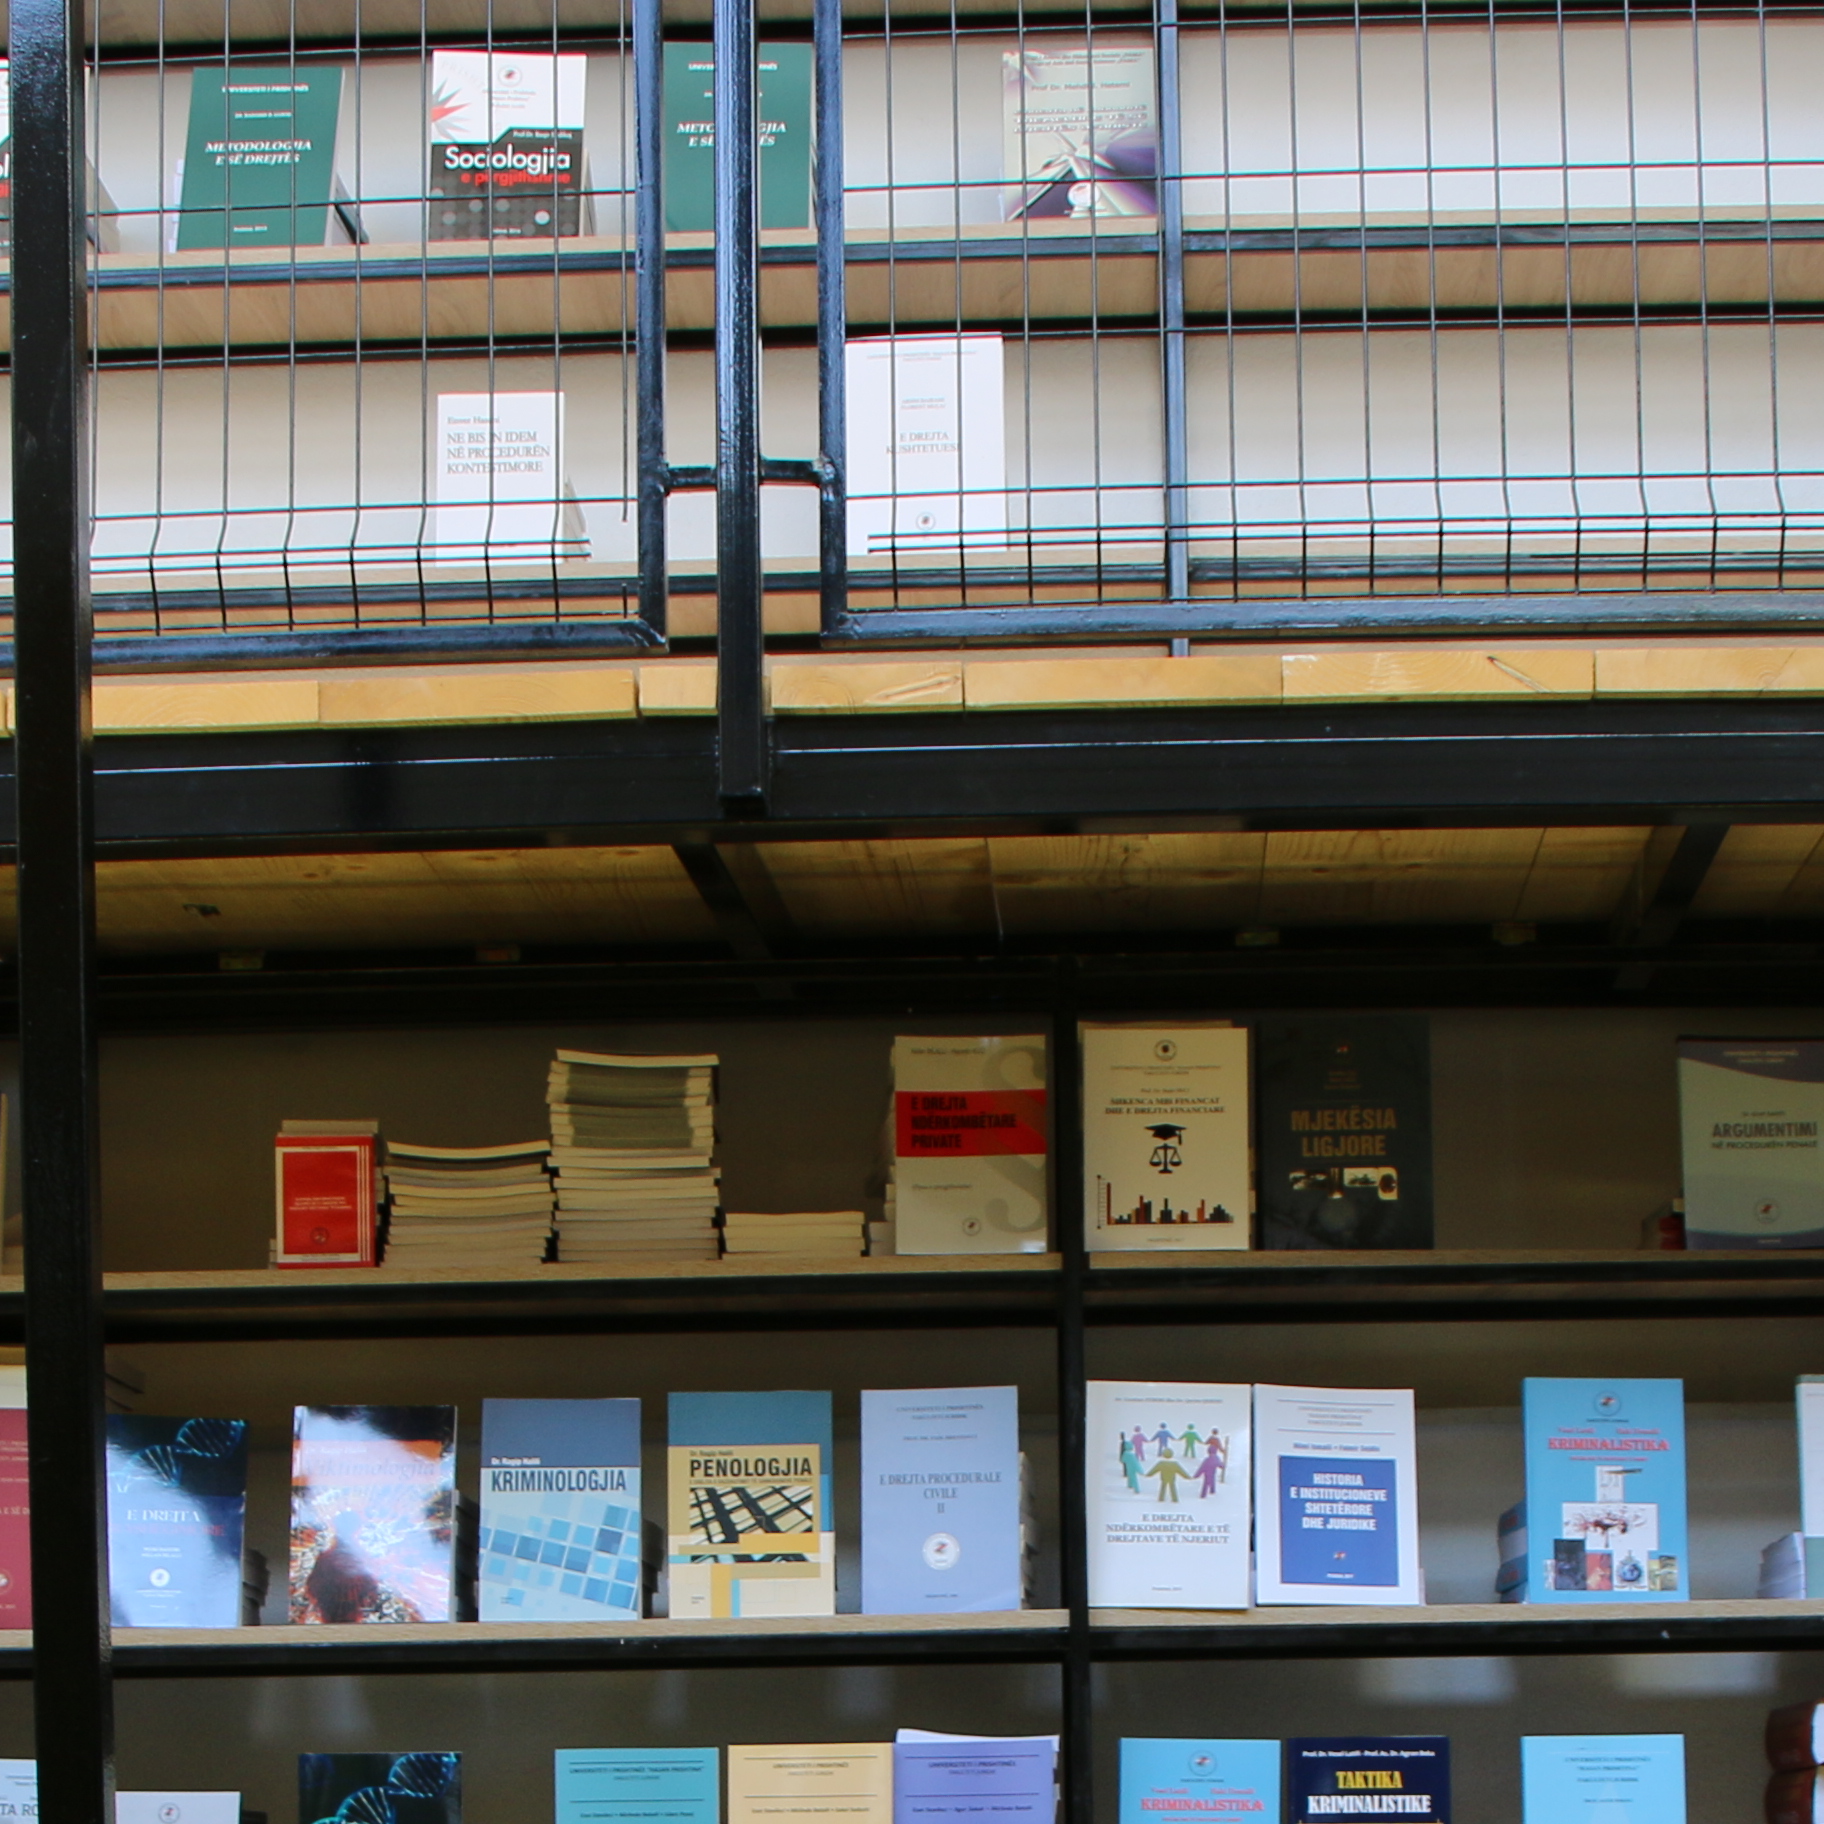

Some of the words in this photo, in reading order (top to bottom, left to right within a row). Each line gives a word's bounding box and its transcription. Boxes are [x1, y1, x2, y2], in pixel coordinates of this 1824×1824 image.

[444, 143, 571, 174] Sociologjia
[447, 431, 463, 444] NE
[467, 431, 485, 444] BIS
[506, 431, 537, 444] IDEM
[447, 444, 463, 458] NË
[467, 444, 551, 458] PROCEDURËN
[447, 461, 543, 474] KONTESTIMORE
[1290, 1108, 1397, 1131] MJEKËSIA
[1712, 1121, 1818, 1139] ARGUMENTIMI
[1302, 1134, 1386, 1157] LIGJORE
[1547, 1437, 1669, 1451] KRIMINALISTIKA
[689, 1456, 813, 1479] PENOLOGJIA
[491, 1468, 627, 1492] KRIMINOLOGJIA
[889, 1473, 923, 1486] DREJTA
[926, 1470, 1002, 1485] PROCEDURALE
[1313, 1474, 1364, 1488] HISTORIA
[923, 1487, 959, 1500] CIVILE
[1300, 1488, 1387, 1502] INSTITUCIONEVE
[1305, 1502, 1373, 1517] SHTETËRORE
[1153, 1513, 1194, 1523] DREJTA
[1303, 1518, 1320, 1533] DHE
[1324, 1518, 1378, 1533] JURIDIKE
[1336, 1771, 1403, 1789] TAKTIKA
[1140, 1798, 1264, 1812] KRIMINALISTIKA
[1307, 1795, 1432, 1814] KRIMINALISTIKE
